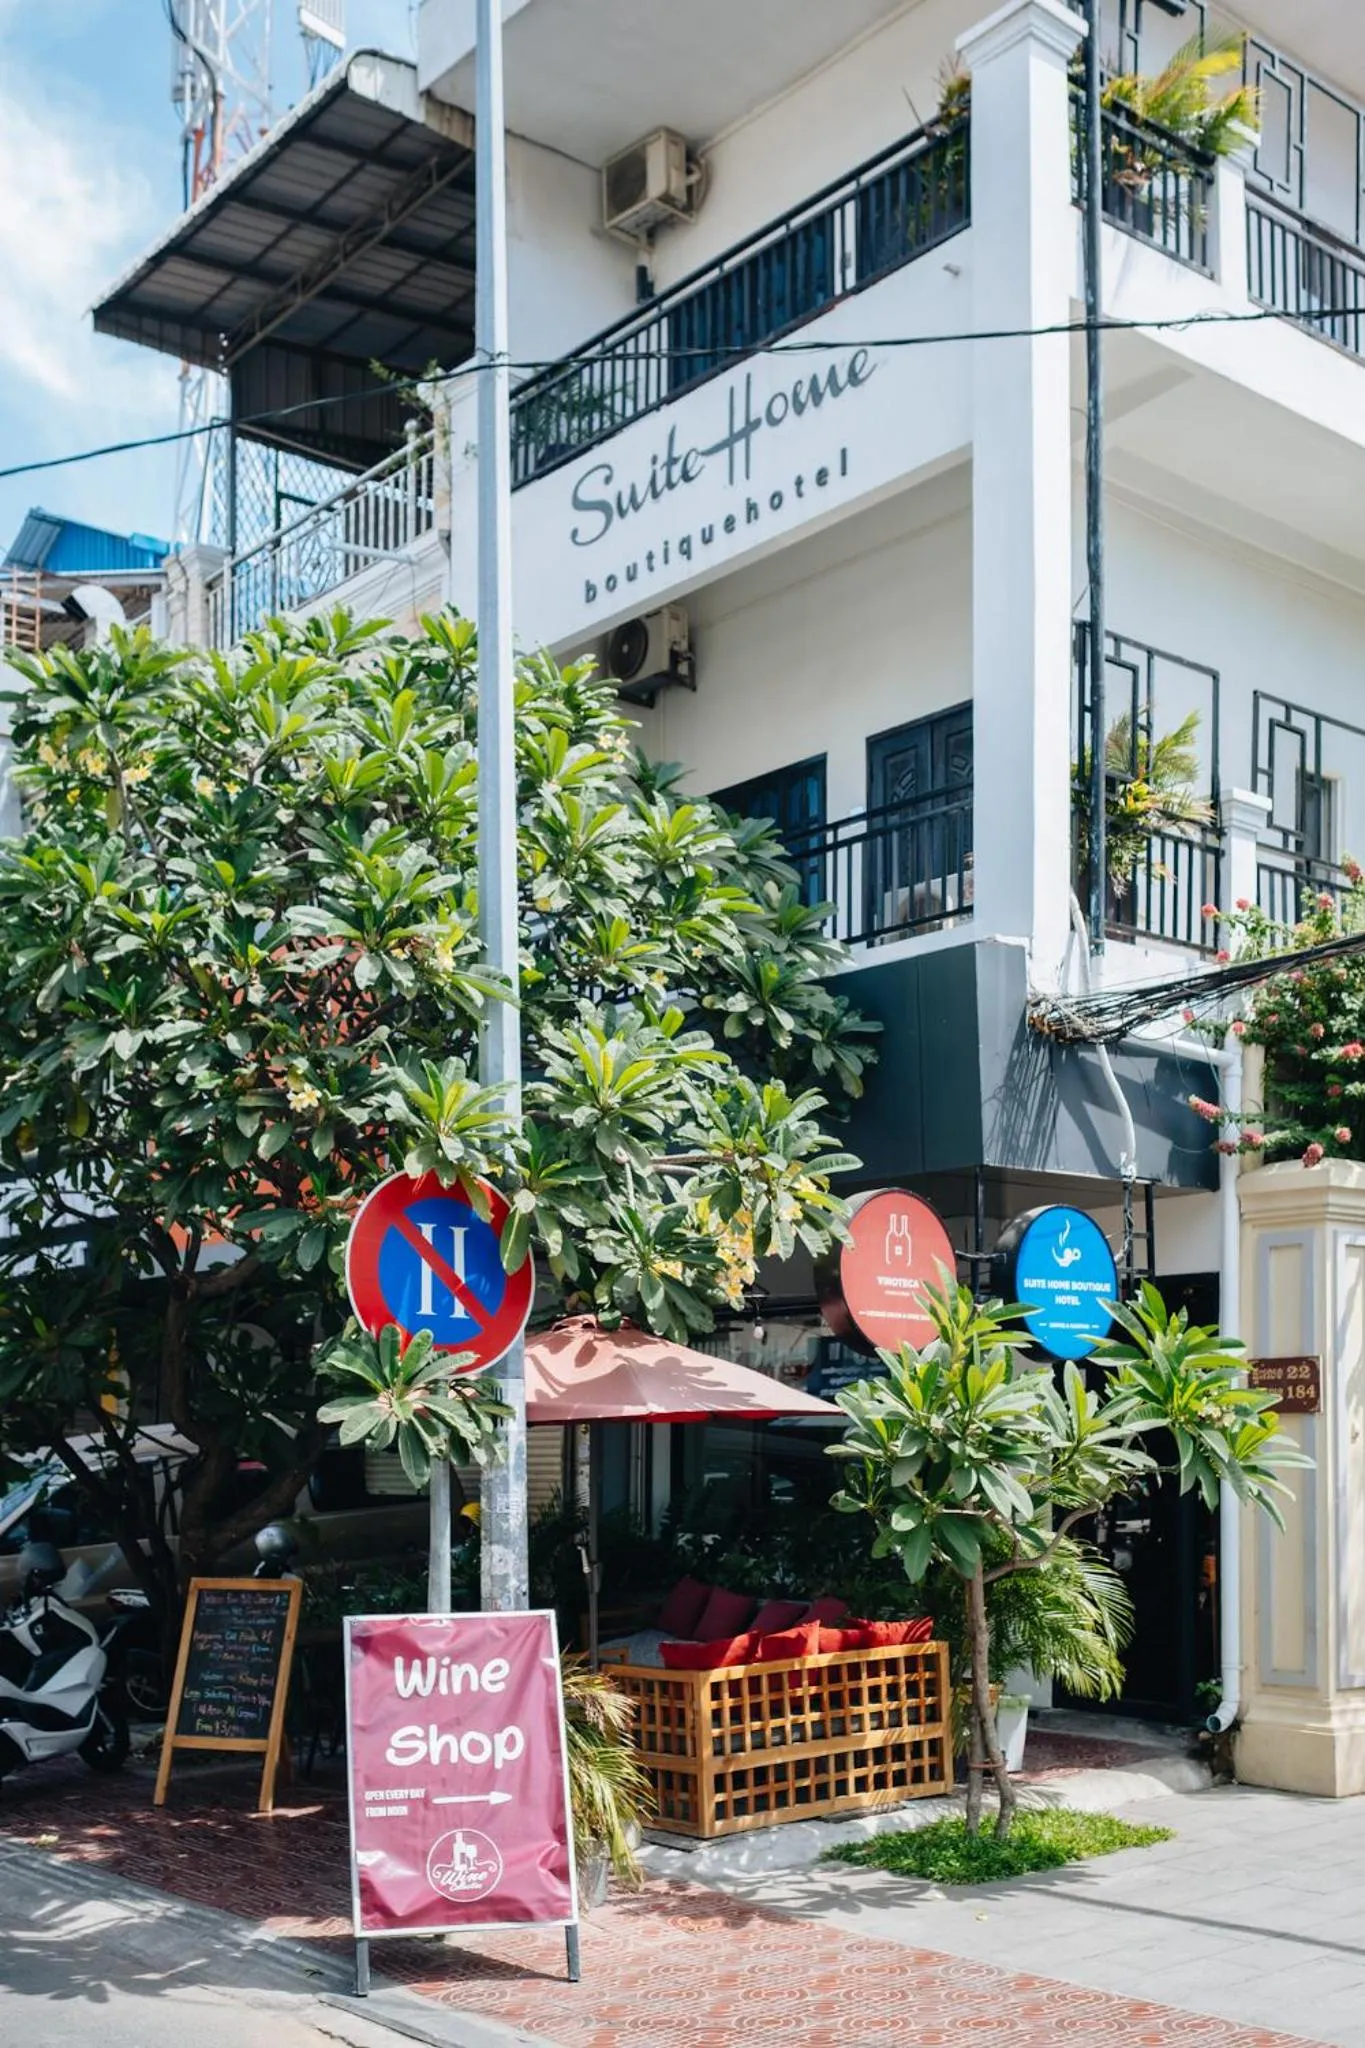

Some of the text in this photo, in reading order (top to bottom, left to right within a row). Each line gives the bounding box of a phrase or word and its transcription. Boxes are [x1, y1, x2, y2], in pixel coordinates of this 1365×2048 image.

[571, 348, 879, 547] Suite Home
[876, 1276, 920, 1289] VINOTECA
[1023, 1277, 1112, 1293] SUITE HOME BOUTIQUE
[1054, 1294, 1082, 1306] HOTEL
[1286, 1365, 1311, 1380] 22
[1286, 1384, 1316, 1399] 184
[394, 1655, 511, 1699] Wine
[385, 1724, 525, 1770] Shop
[364, 1788, 426, 1802] OPEN EVERY DAY
[440, 1870, 488, 1886] Wine
